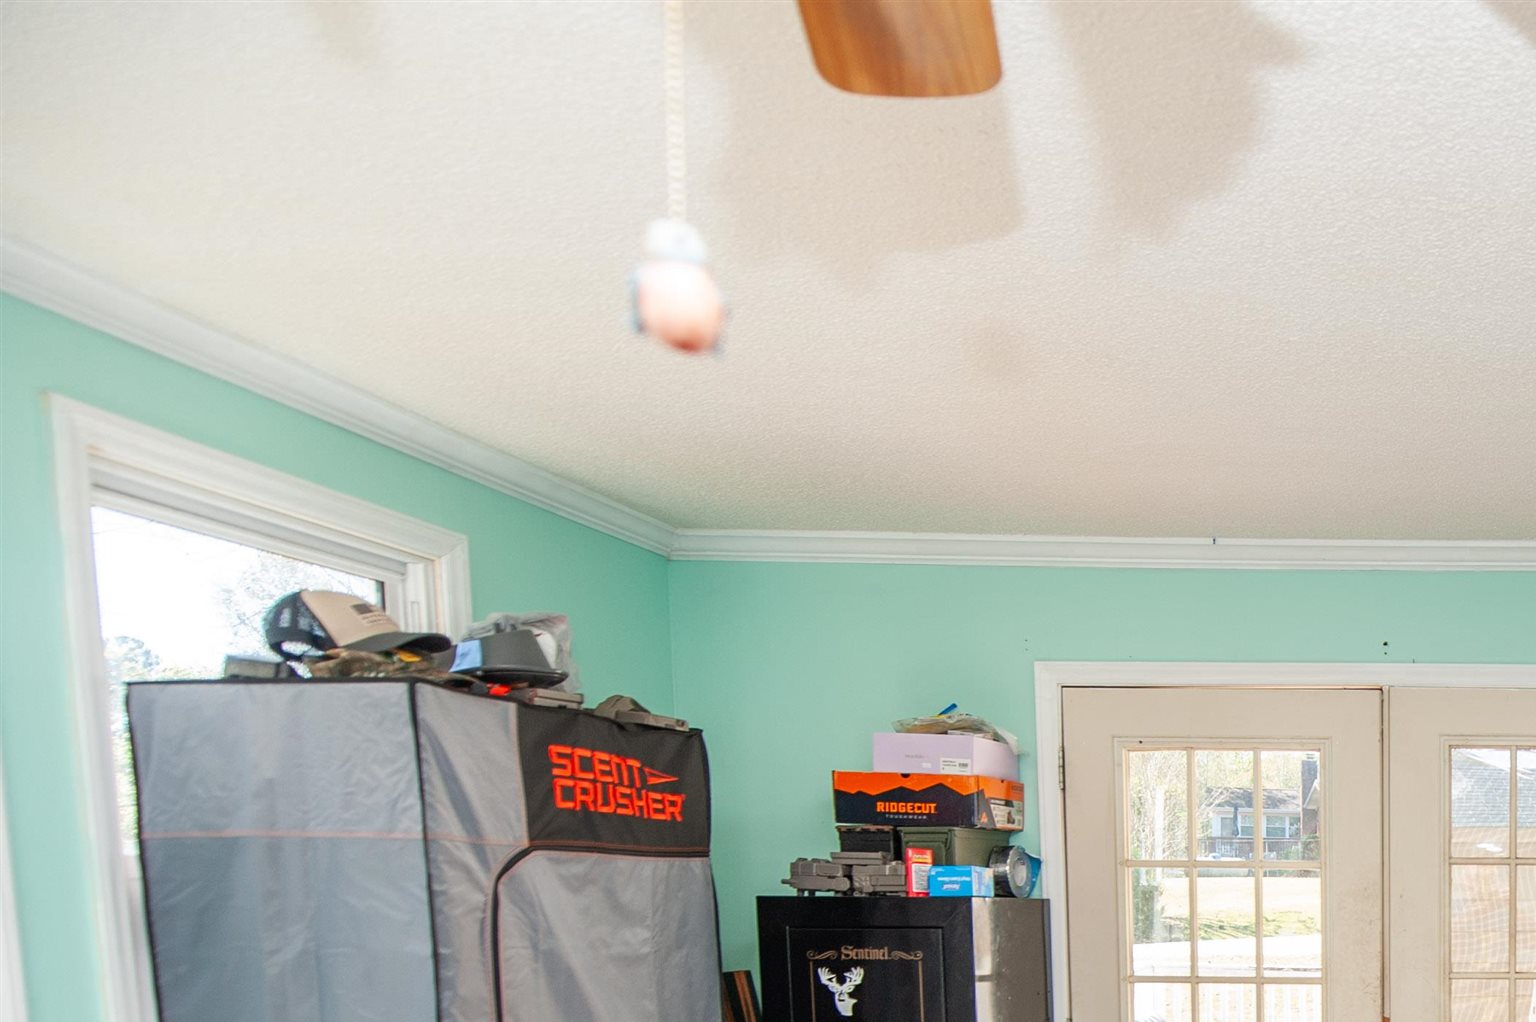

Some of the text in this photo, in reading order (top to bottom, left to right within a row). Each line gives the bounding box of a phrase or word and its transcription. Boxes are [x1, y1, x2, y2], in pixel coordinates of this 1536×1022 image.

[548, 744, 642, 788] SCENT
[553, 777, 686, 822] CRUSHER
[876, 801, 937, 814] RIDGECUT
[840, 945, 890, 961] Sentinel
